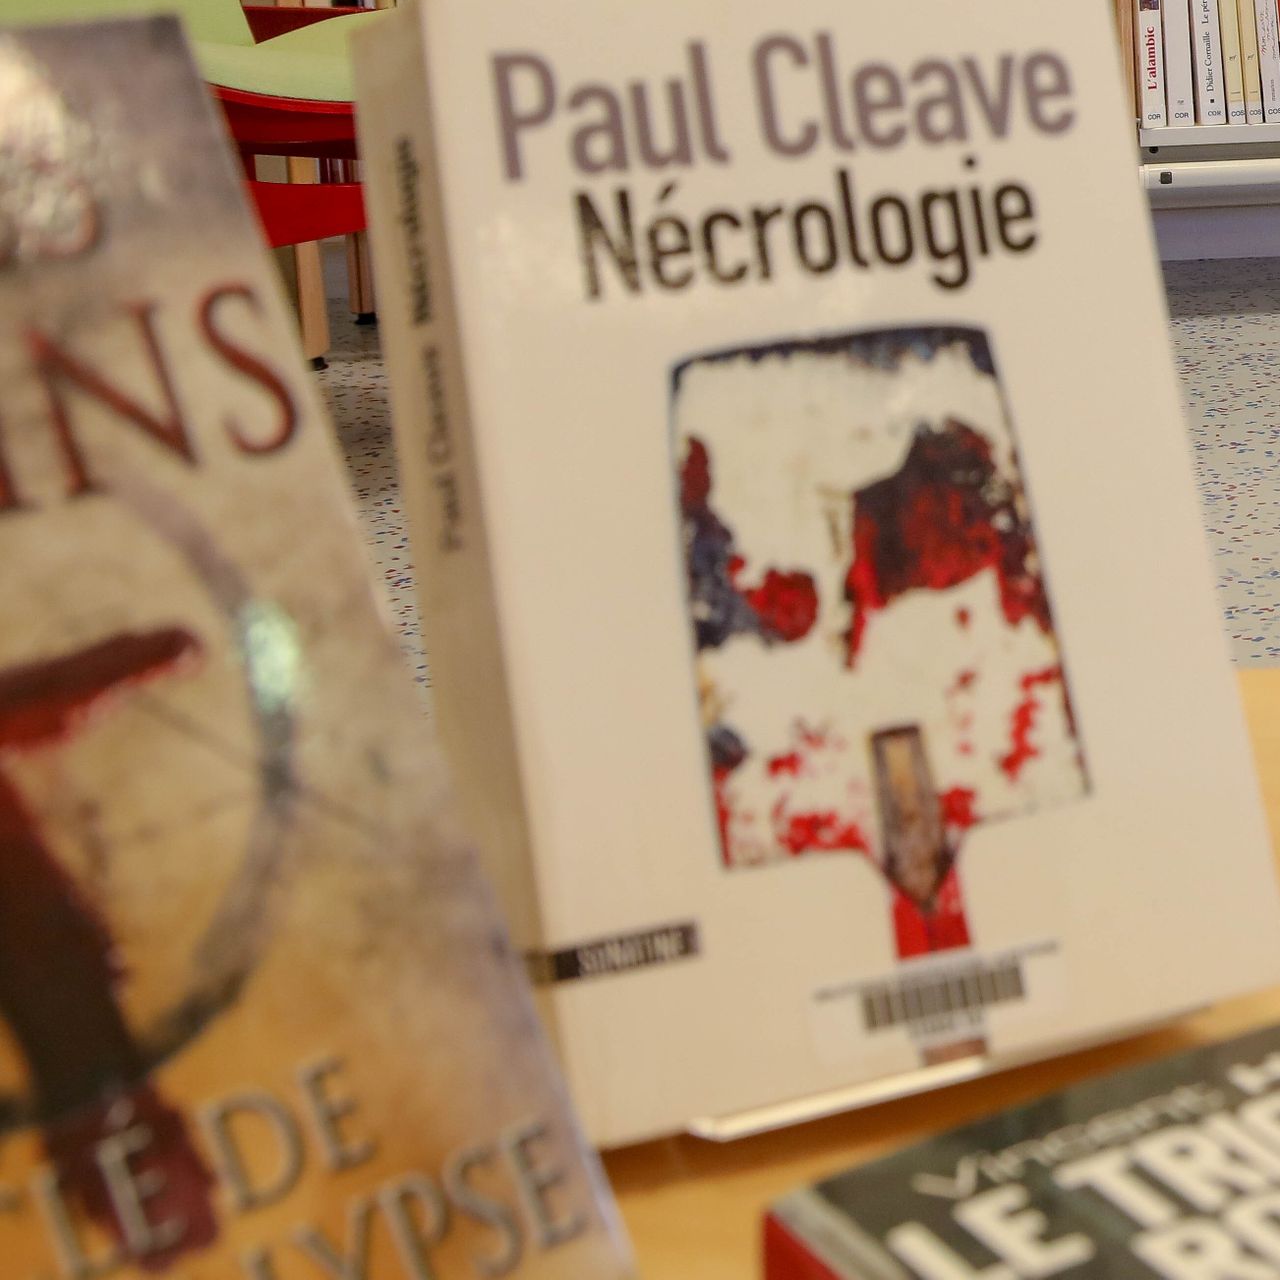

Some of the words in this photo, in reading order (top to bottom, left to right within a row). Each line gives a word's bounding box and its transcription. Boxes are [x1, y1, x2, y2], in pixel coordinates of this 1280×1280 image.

[1147, 27, 1157, 91] L'alambic
[1201, 16, 1209, 25] Le
[1204, 31, 1214, 67] Cornaille
[491, 46, 733, 184] Paul
[752, 34, 1077, 157] Cleave
[1207, 69, 1215, 92] Didier
[577, 160, 1037, 303] Nécrologie
[199, 1056, 377, 1212] DE
[886, 1183, 1096, 1280] LE
